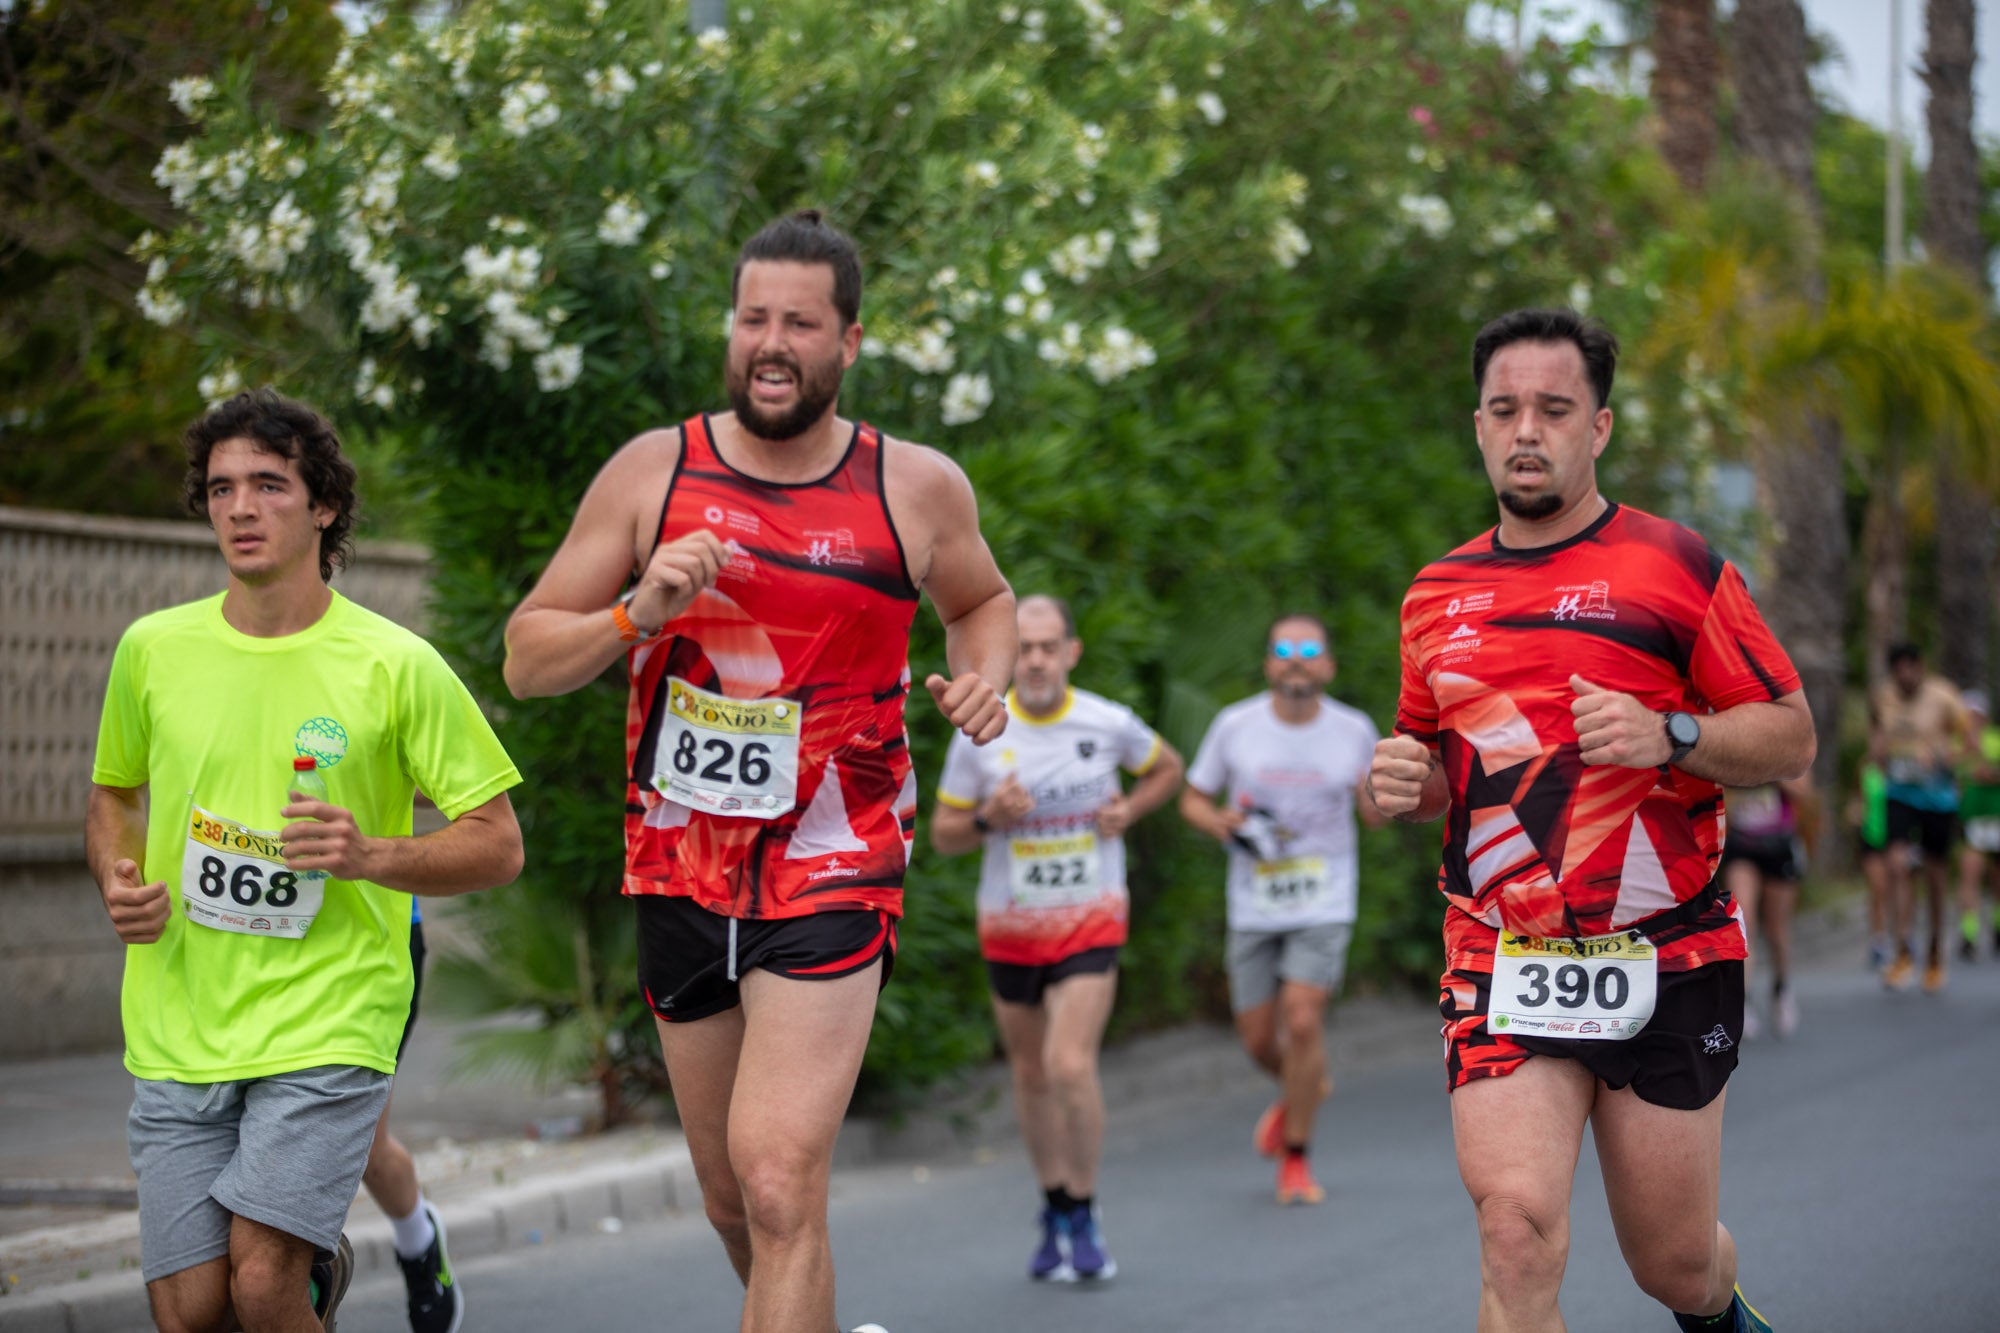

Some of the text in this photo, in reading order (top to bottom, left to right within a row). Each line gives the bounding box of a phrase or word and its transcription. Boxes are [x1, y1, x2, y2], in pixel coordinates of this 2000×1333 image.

[1577, 612, 1616, 620] ALBOLOTE
[674, 730, 771, 786] 826
[204, 820, 223, 842] 38
[199, 855, 298, 908] 868
[807, 868, 861, 881] TEAMERGY
[1025, 858, 1087, 887] 422
[1516, 963, 1629, 1011] 390
[1511, 1018, 1546, 1028] Cruzcampo
